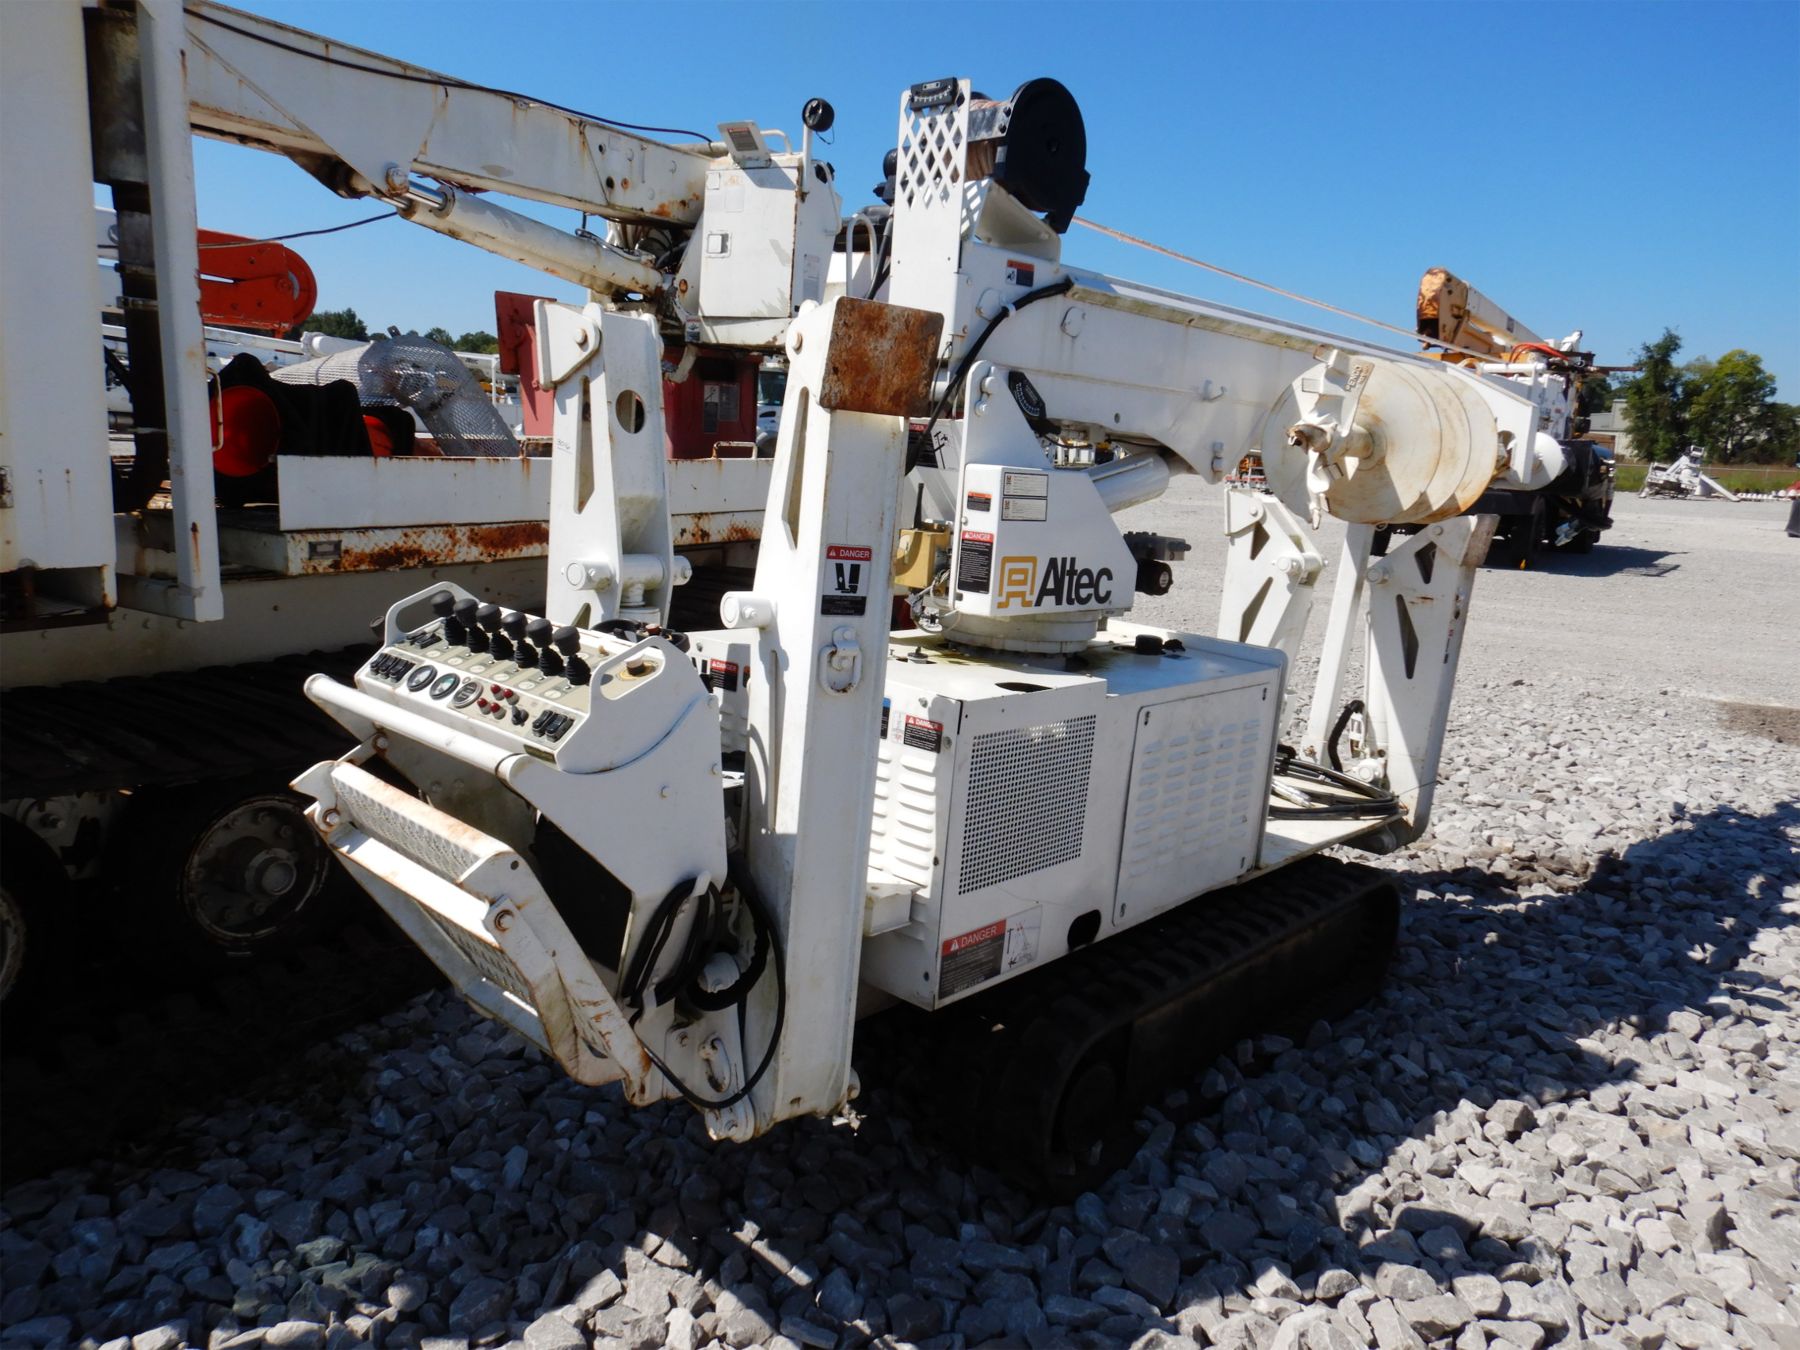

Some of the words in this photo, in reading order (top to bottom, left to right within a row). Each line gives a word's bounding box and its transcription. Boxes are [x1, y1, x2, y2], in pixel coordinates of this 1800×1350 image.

[968, 532, 991, 540] DANGER
[840, 549, 870, 558] DANGER
[1034, 557, 1113, 606] Altec
[915, 718, 938, 728] DANGER
[961, 926, 997, 948] DANGER
